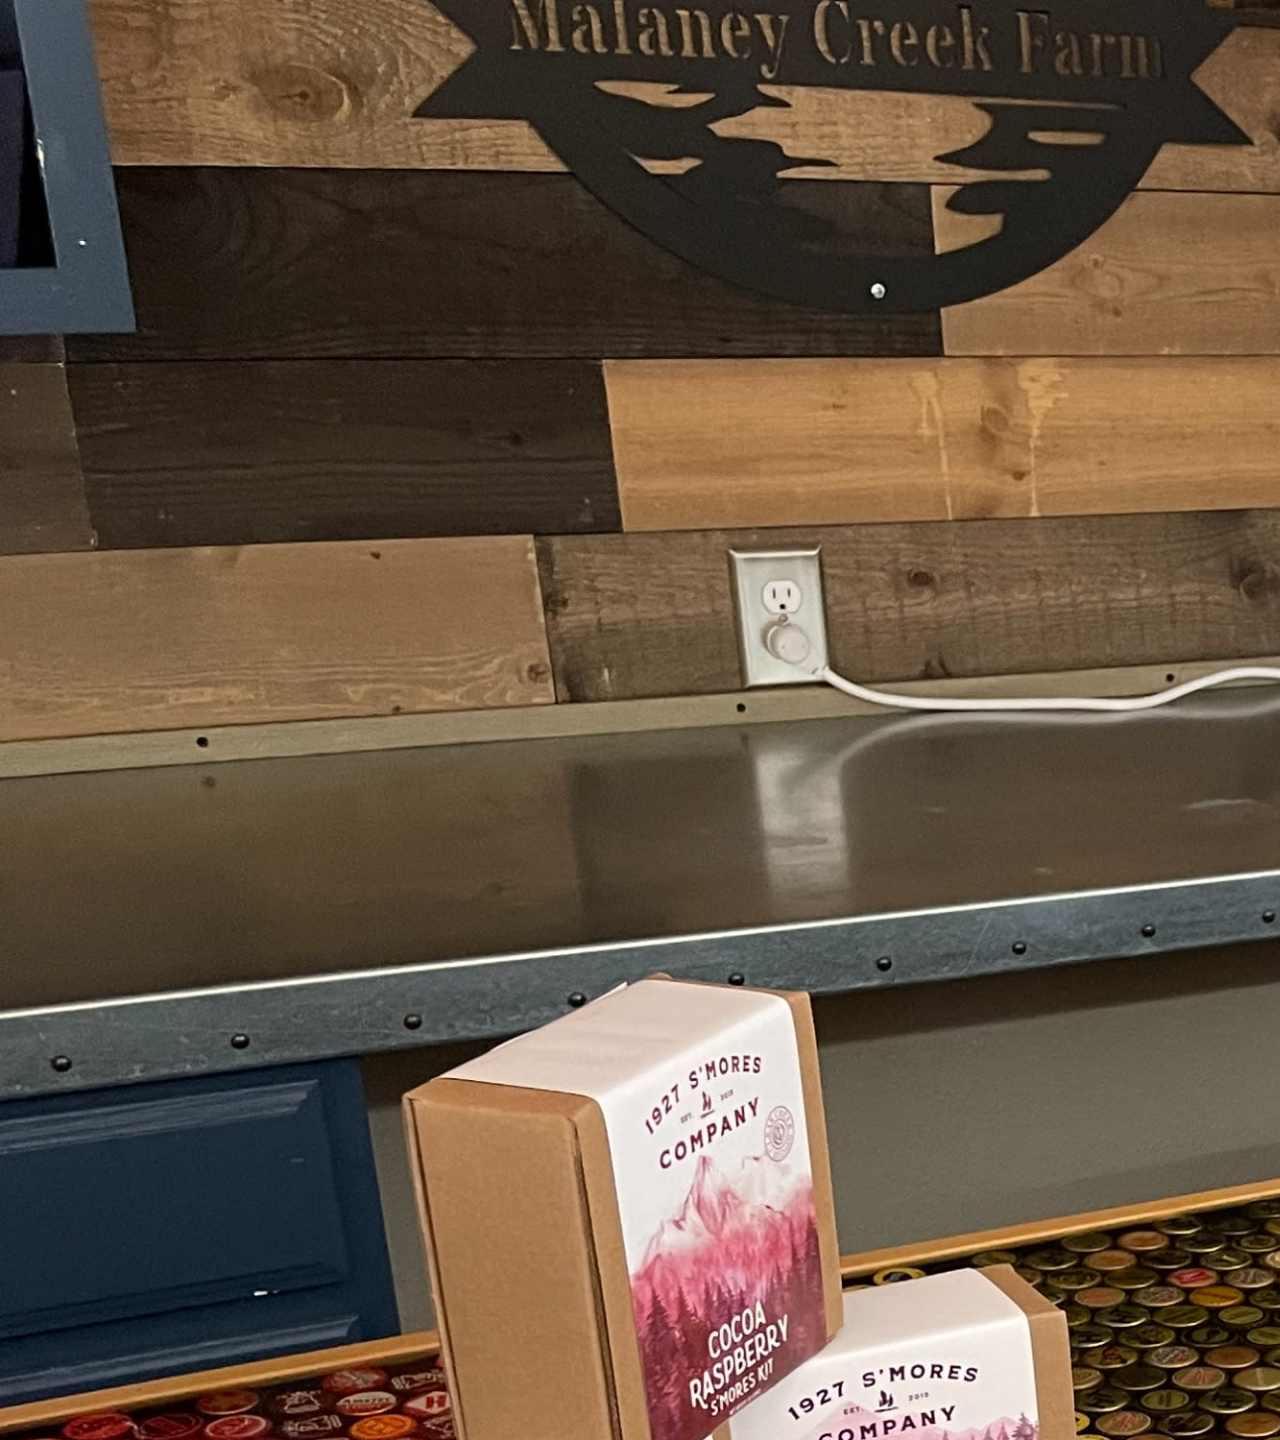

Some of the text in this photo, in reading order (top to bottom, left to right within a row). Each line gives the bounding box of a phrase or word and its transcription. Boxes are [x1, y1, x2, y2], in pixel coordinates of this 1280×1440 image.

[508, 0, 1167, 79] Malaney Creek Farm
[644, 1055, 762, 1135] 1927 S'MORES
[659, 1097, 761, 1170] COMPANY
[688, 1313, 789, 1410] RASPBERRY
[707, 1302, 767, 1359] COCOA
[710, 1375, 756, 1416] S'MORES
[755, 1359, 775, 1389] KIT
[787, 1381, 847, 1421] 1927
[862, 1363, 980, 1388] S'MORES
